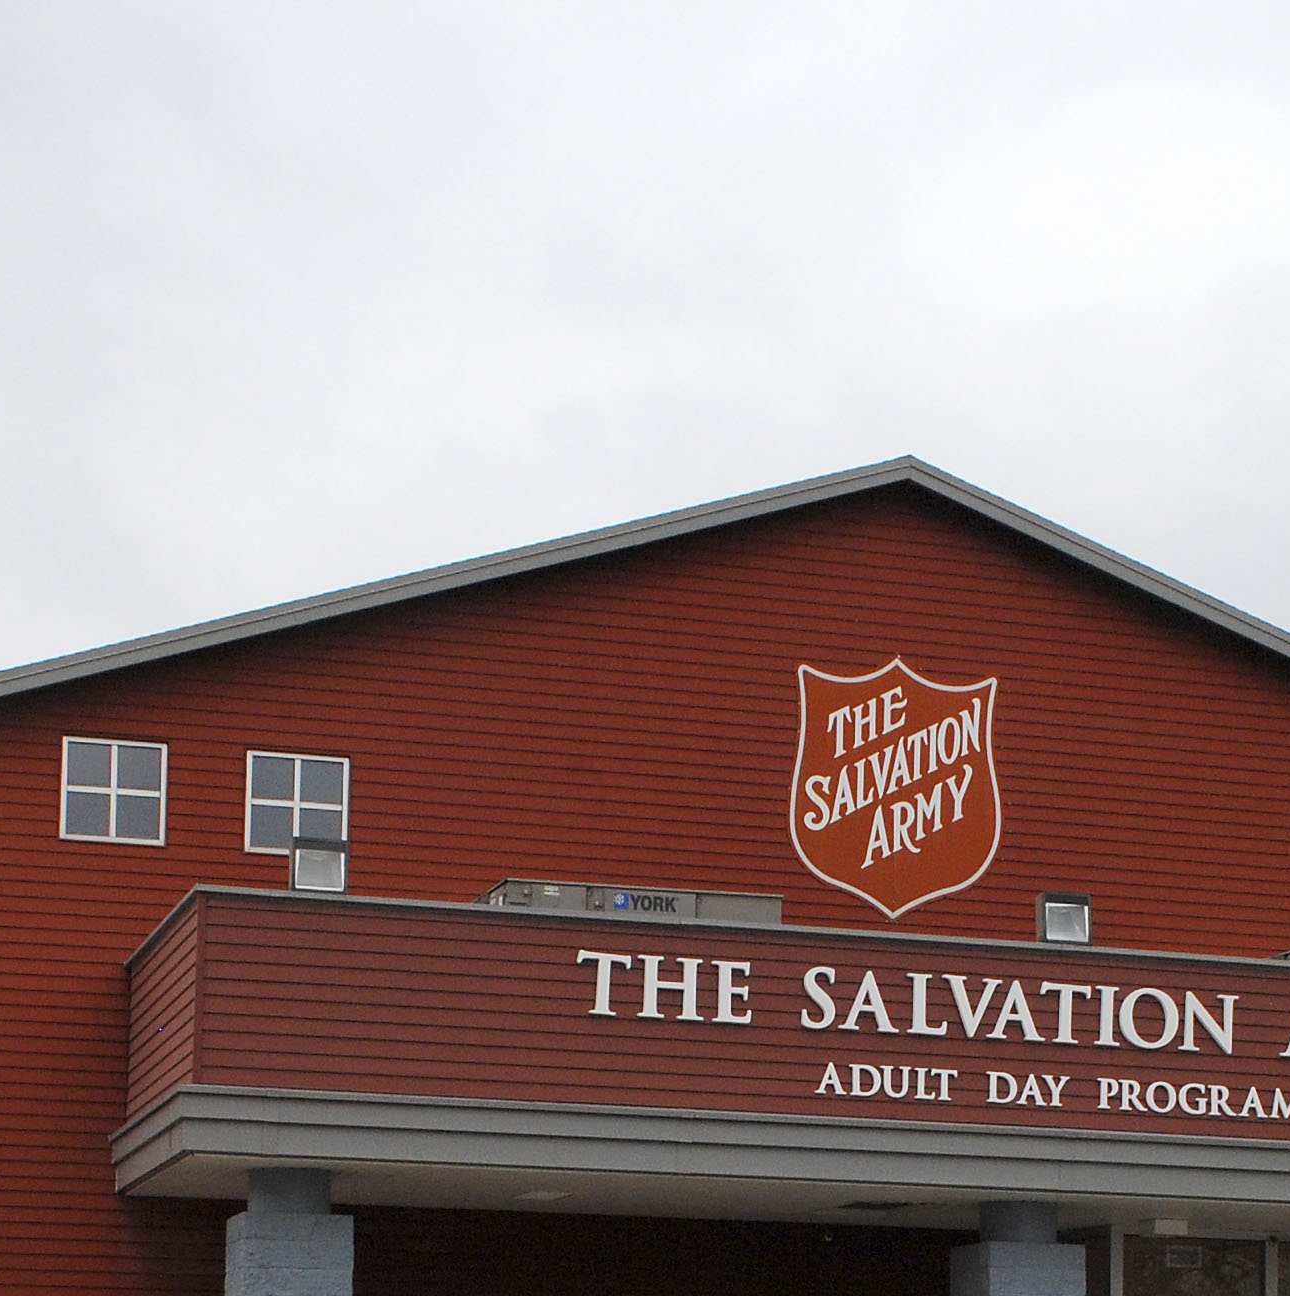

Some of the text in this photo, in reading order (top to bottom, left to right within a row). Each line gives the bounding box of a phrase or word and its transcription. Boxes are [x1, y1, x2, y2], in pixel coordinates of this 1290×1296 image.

[803, 697, 982, 832] SALVATION
[826, 685, 908, 760] THE
[860, 763, 974, 870] ARMY
[630, 893, 677, 913] YORK
[575, 949, 753, 1025] THE
[800, 965, 1240, 1056] SALVATION
[813, 1061, 959, 1102] ADULT
[985, 1070, 1071, 1108] DAY
